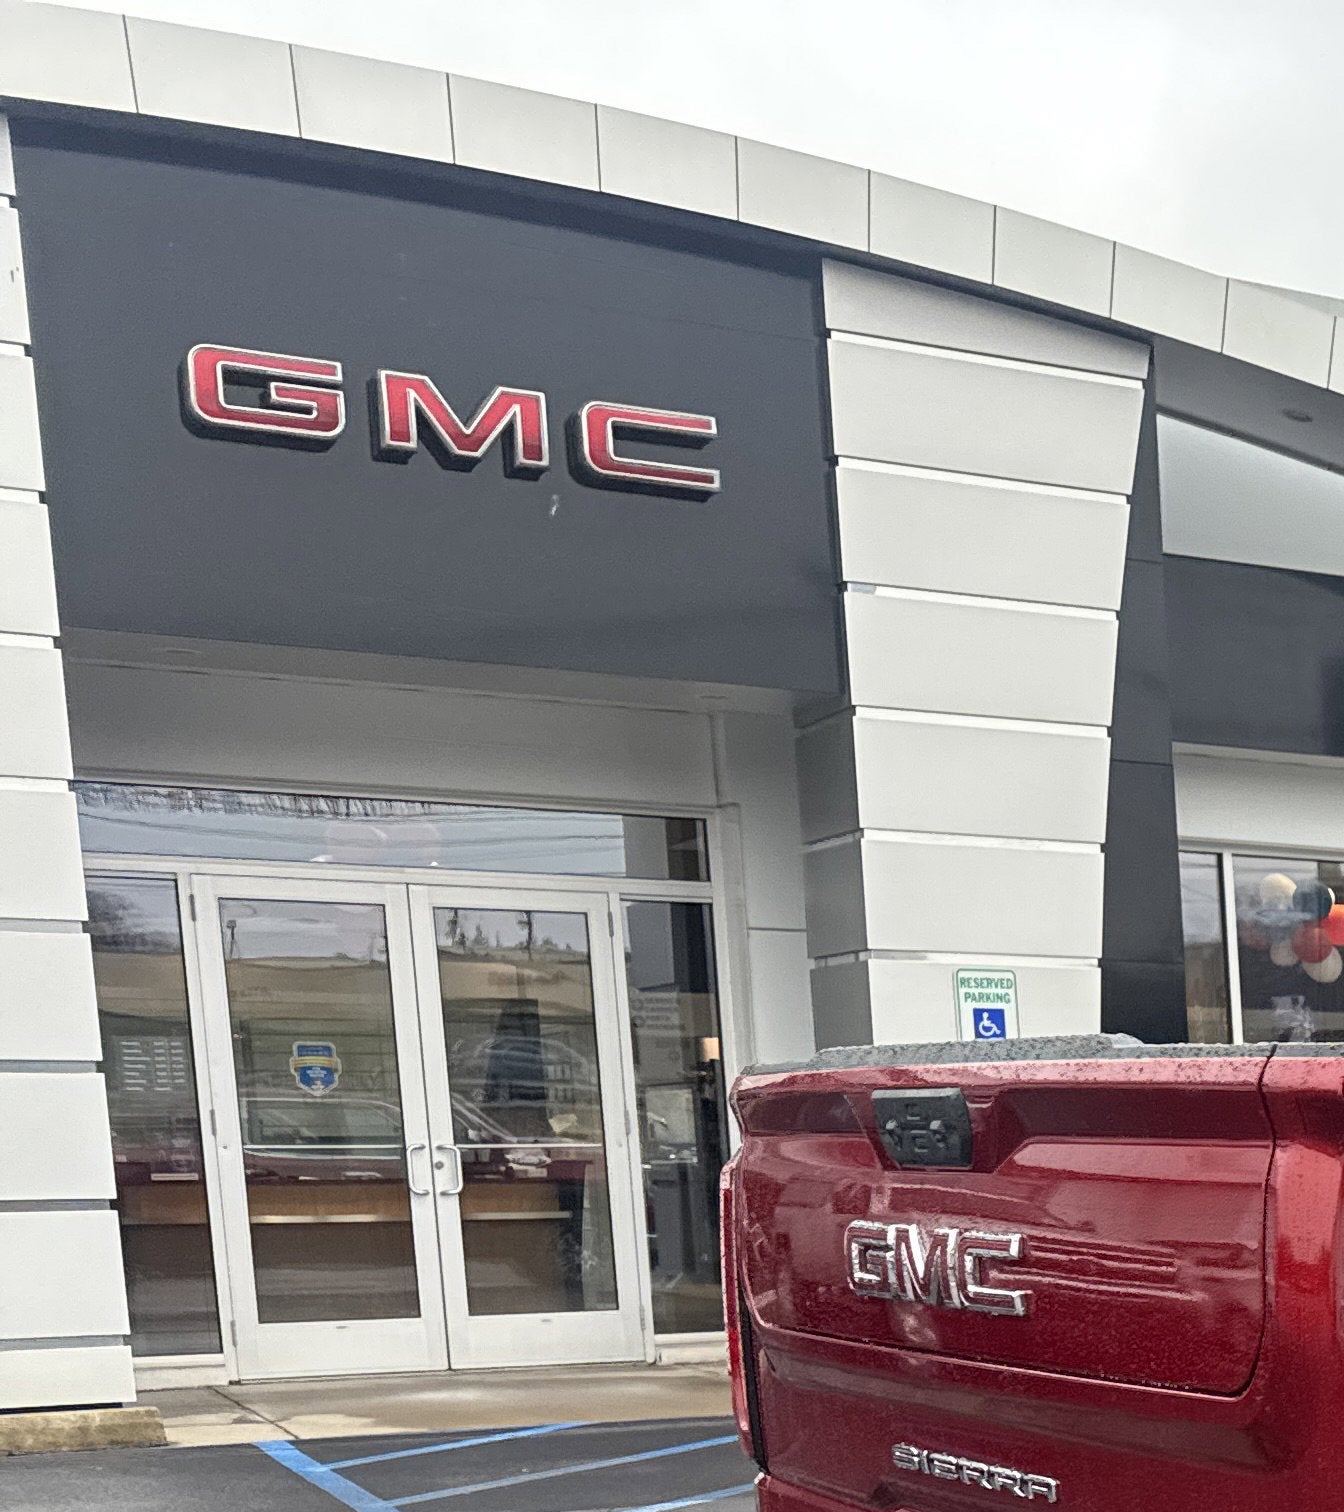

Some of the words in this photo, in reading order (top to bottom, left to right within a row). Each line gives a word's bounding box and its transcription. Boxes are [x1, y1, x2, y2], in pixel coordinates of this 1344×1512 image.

[183, 342, 722, 497] GMC
[959, 976, 1014, 989] RESERVED
[964, 991, 1011, 1004] PARKING
[845, 1219, 1033, 1316] GMC
[892, 1442, 1060, 1503] SIERRA
